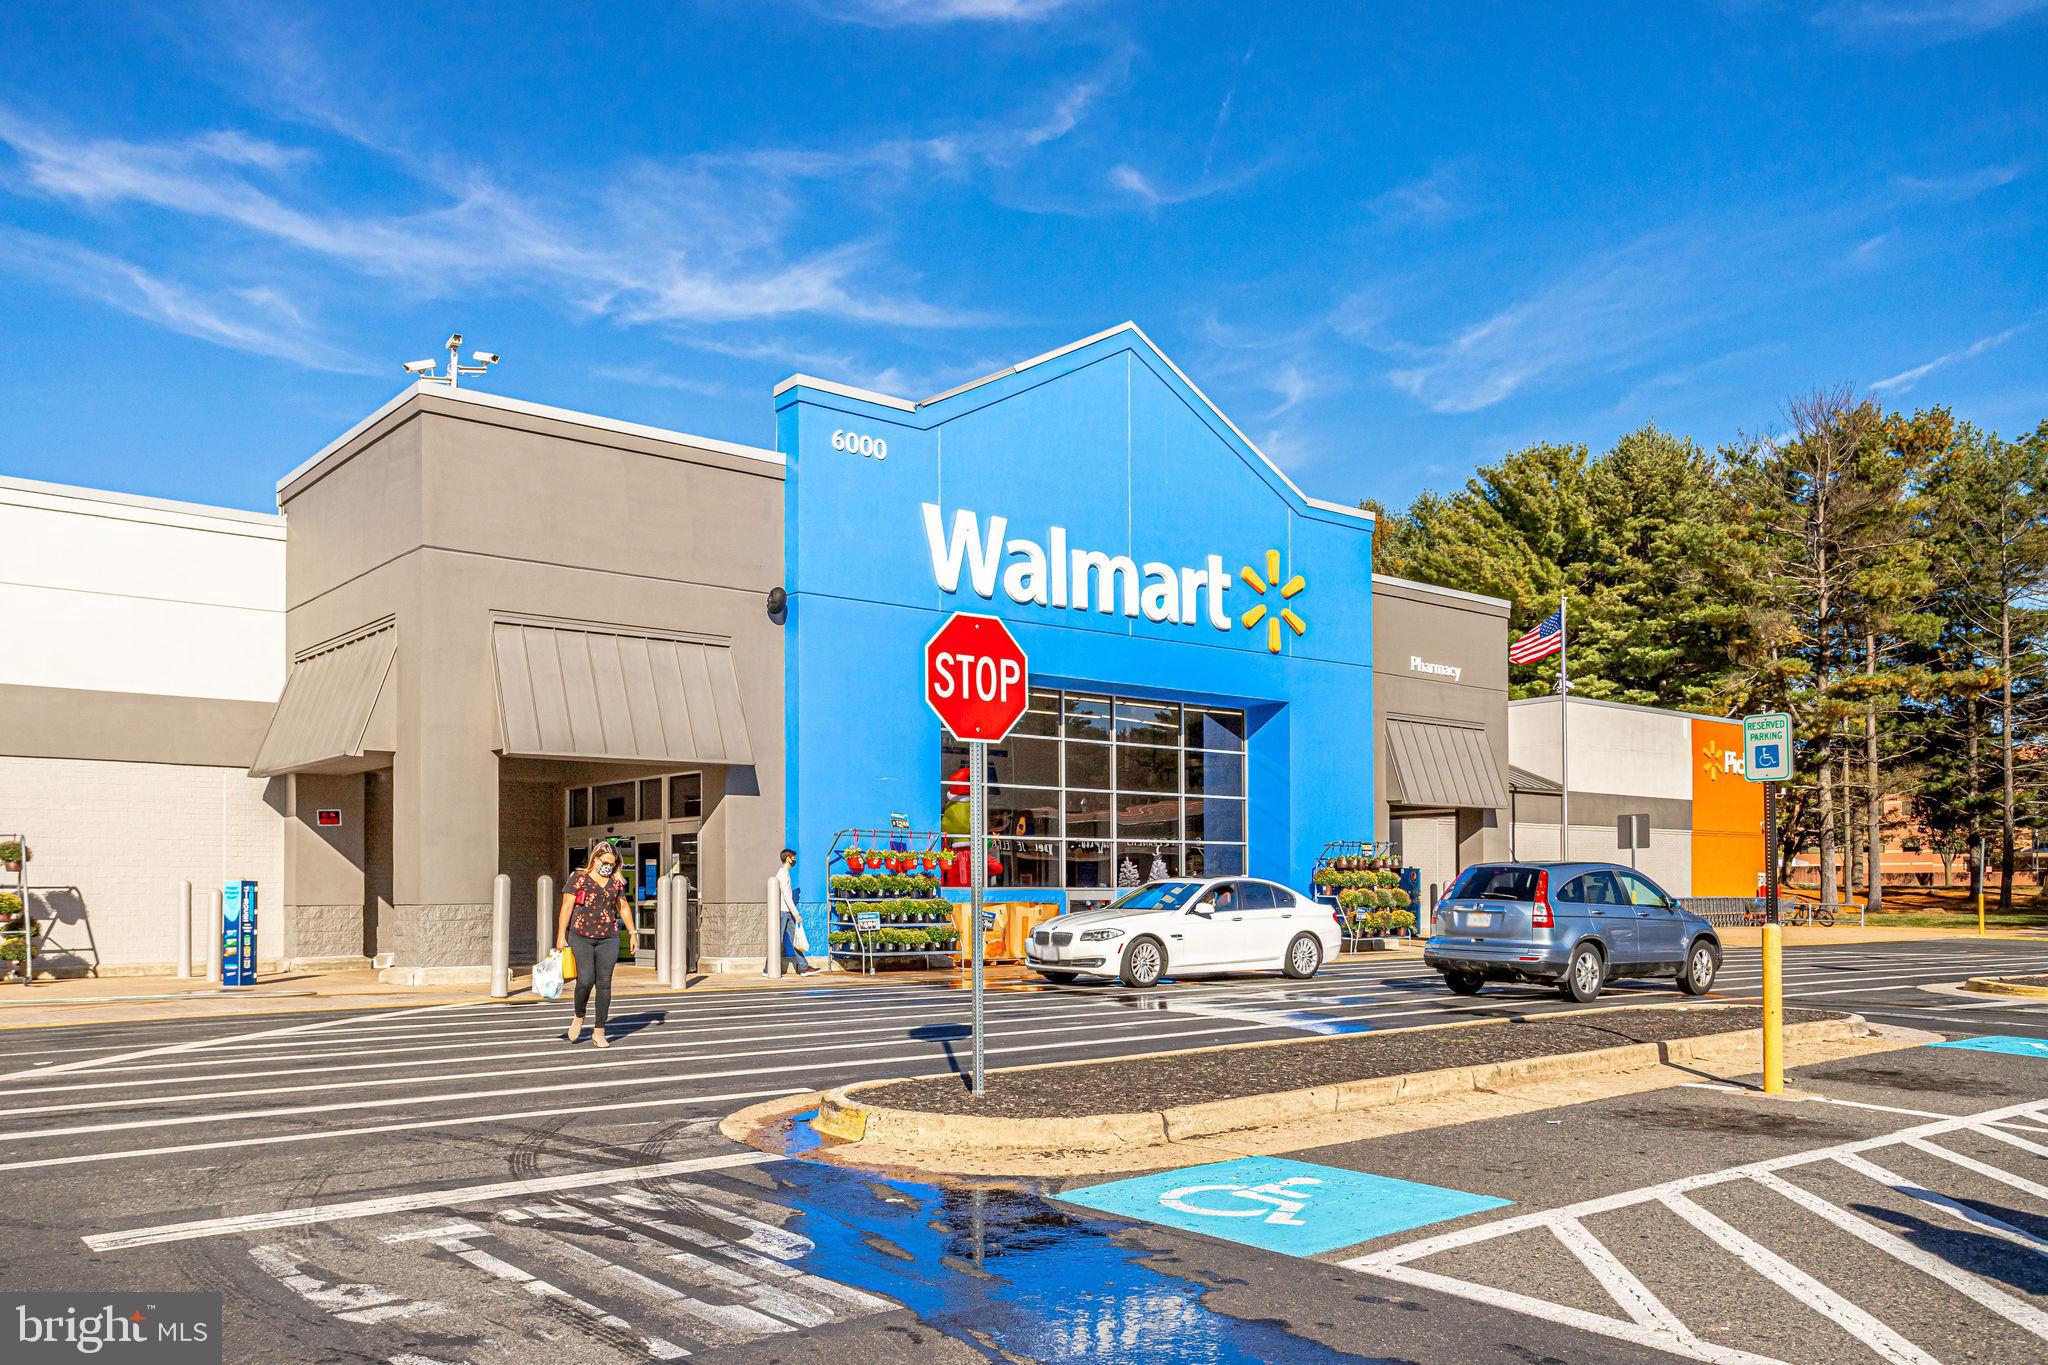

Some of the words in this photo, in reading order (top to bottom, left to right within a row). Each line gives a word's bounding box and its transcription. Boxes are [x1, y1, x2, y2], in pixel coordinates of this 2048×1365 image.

[831, 429, 887, 460] 6000
[921, 502, 1232, 631] Walmart
[934, 651, 1020, 703] STOP
[1410, 655, 1462, 682] Pharmacy
[1747, 720, 1784, 730] RESERVED
[1750, 731, 1783, 741] PARKING
